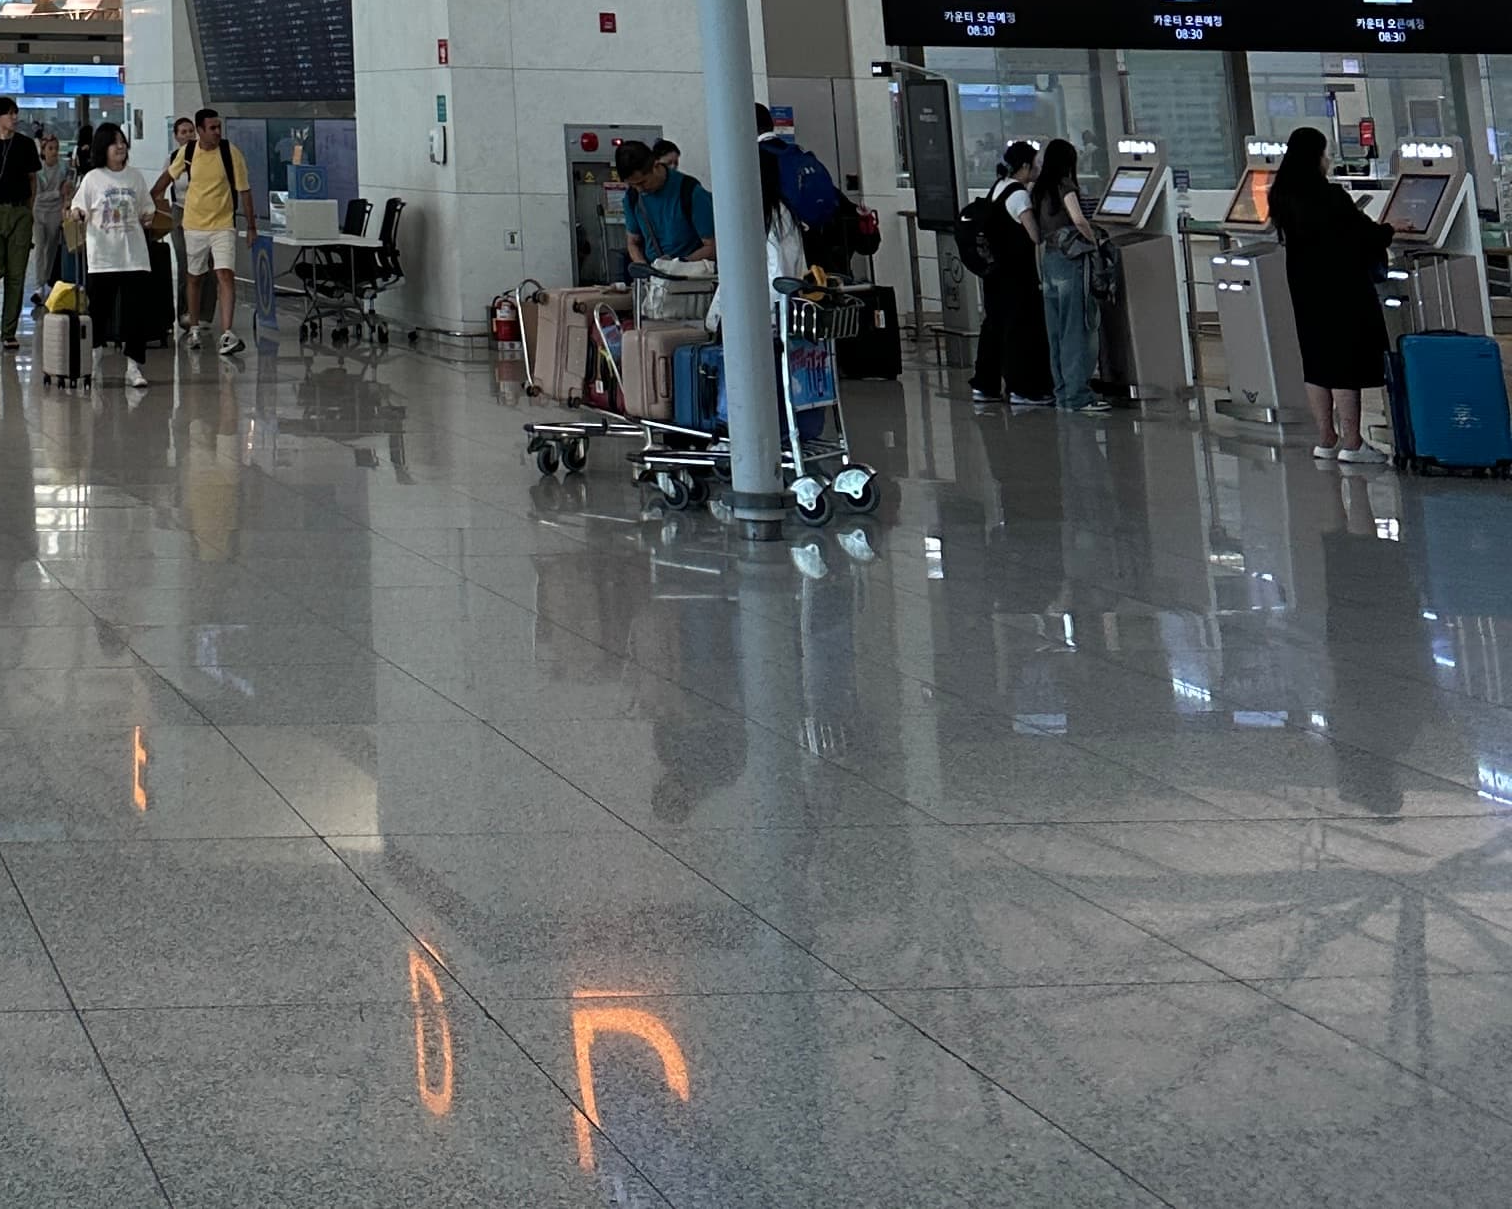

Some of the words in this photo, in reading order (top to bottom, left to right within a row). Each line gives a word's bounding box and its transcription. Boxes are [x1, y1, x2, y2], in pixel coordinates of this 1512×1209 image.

[944, 11, 974, 24] 카운터
[1153, 15, 1182, 27] 카운터
[1356, 18, 1385, 30] 카운터
[967, 25, 995, 36] 08:30
[1175, 28, 1203, 40] 08:30
[1378, 31, 1406, 42] 08:30
